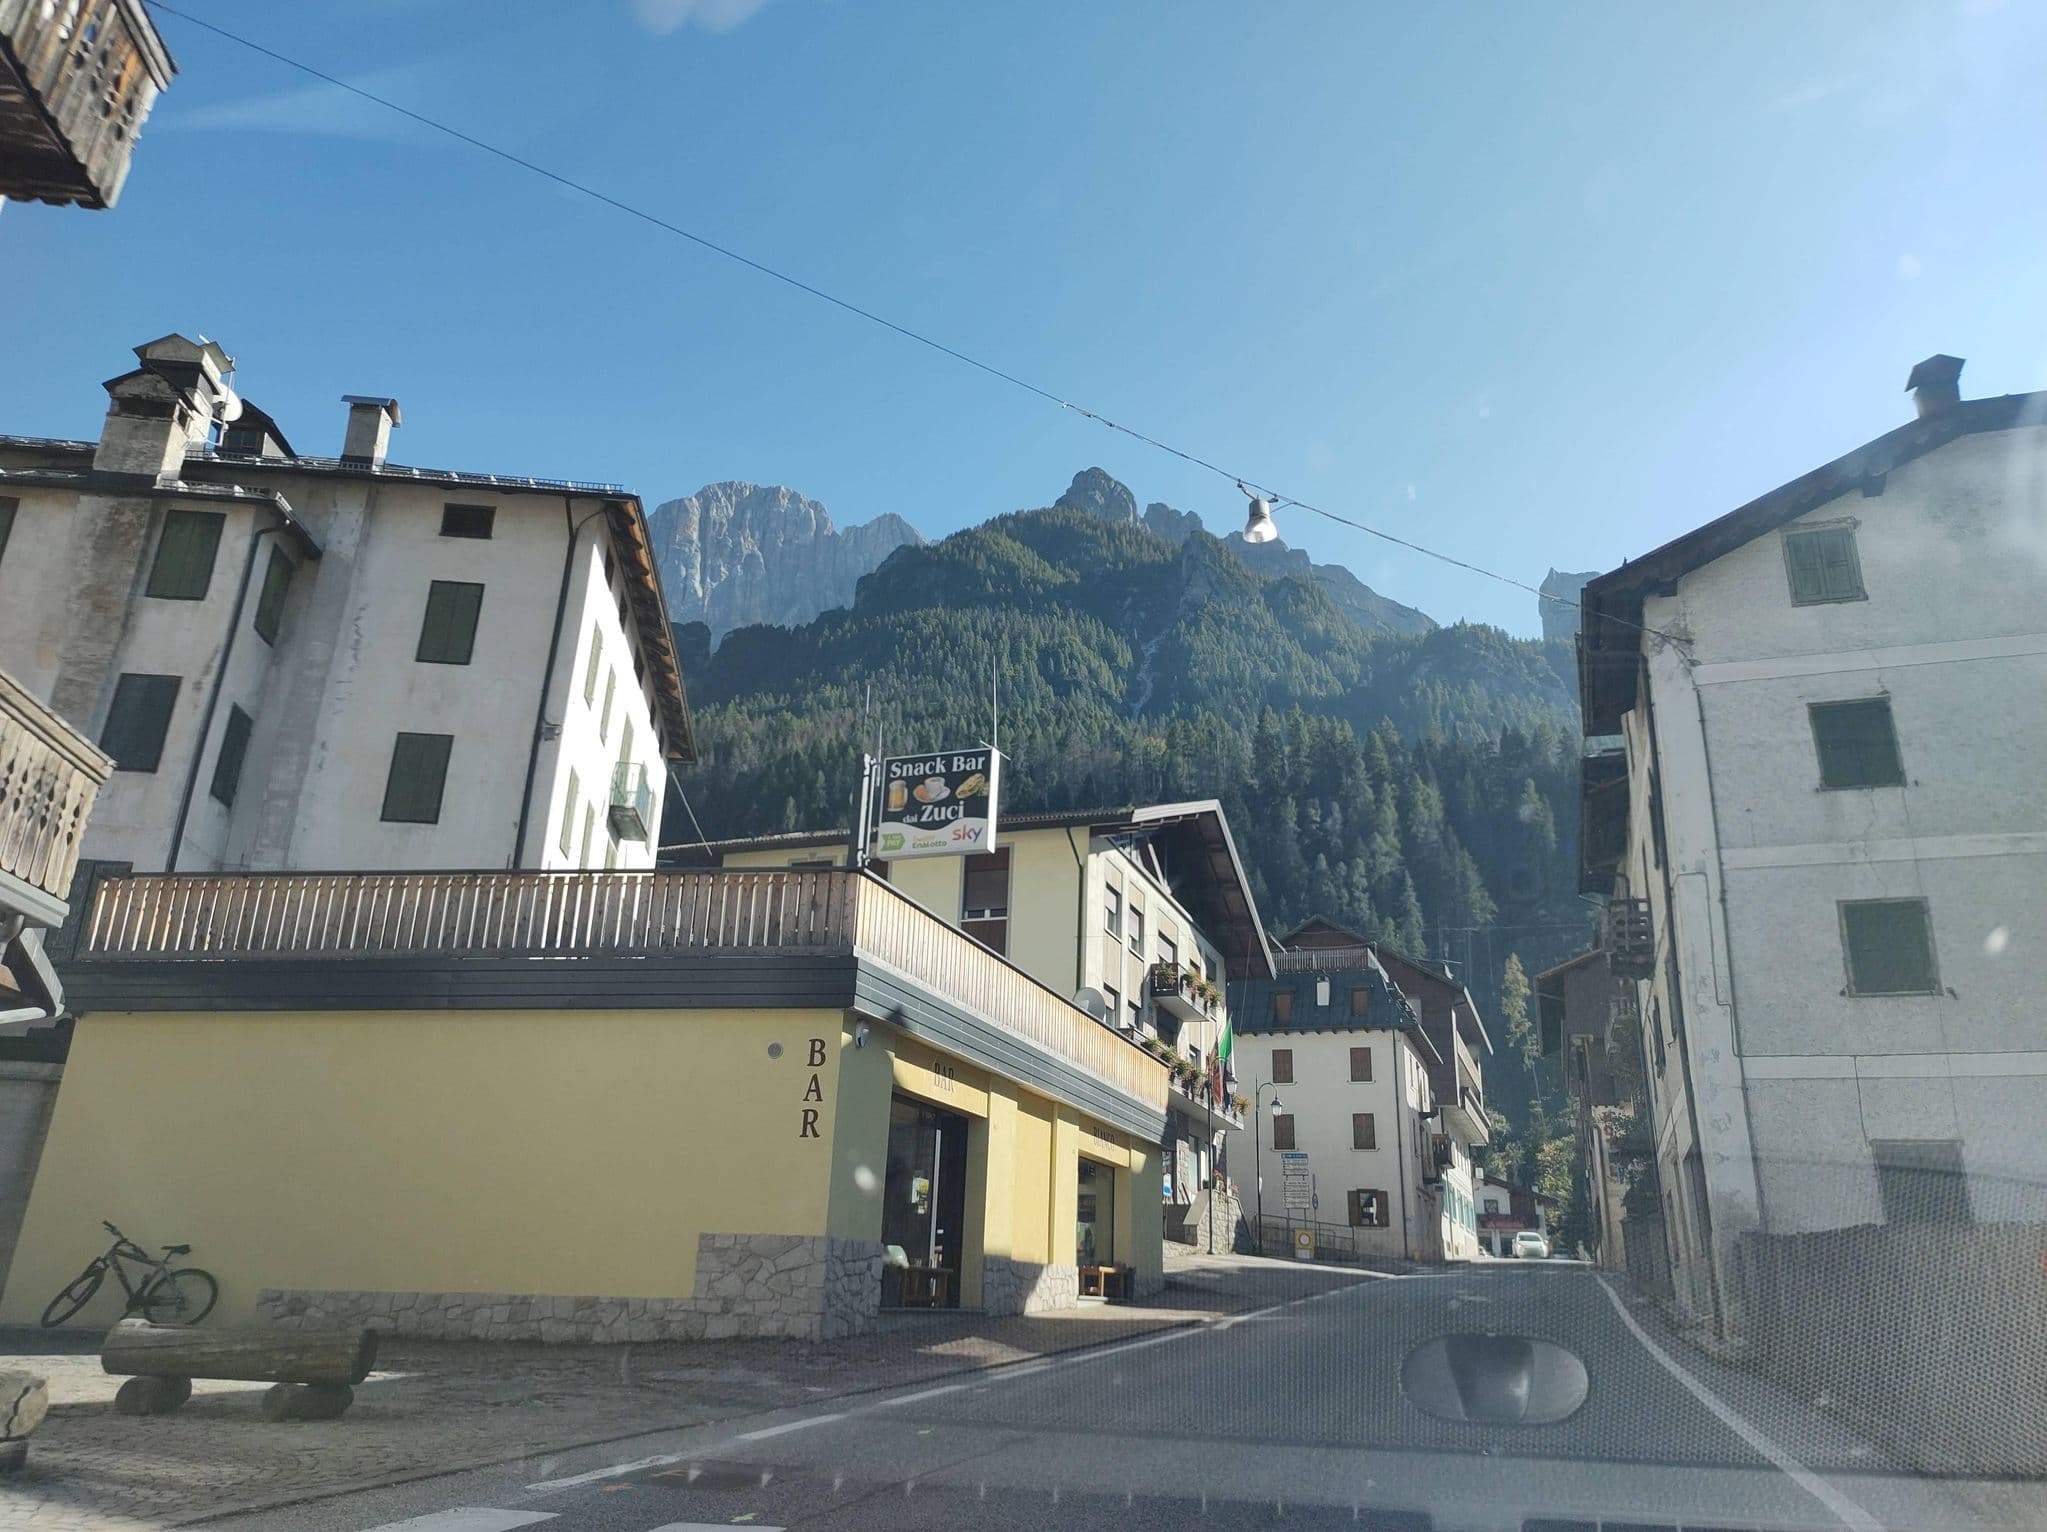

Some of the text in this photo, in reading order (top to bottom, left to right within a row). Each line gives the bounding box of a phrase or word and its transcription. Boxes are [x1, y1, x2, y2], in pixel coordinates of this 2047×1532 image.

[889, 756, 985, 778] Snack Bar
[920, 800, 964, 822] Zuci
[952, 824, 983, 843] sky
[799, 1038, 826, 1138] BAR
[933, 1062, 955, 1093] BAR
